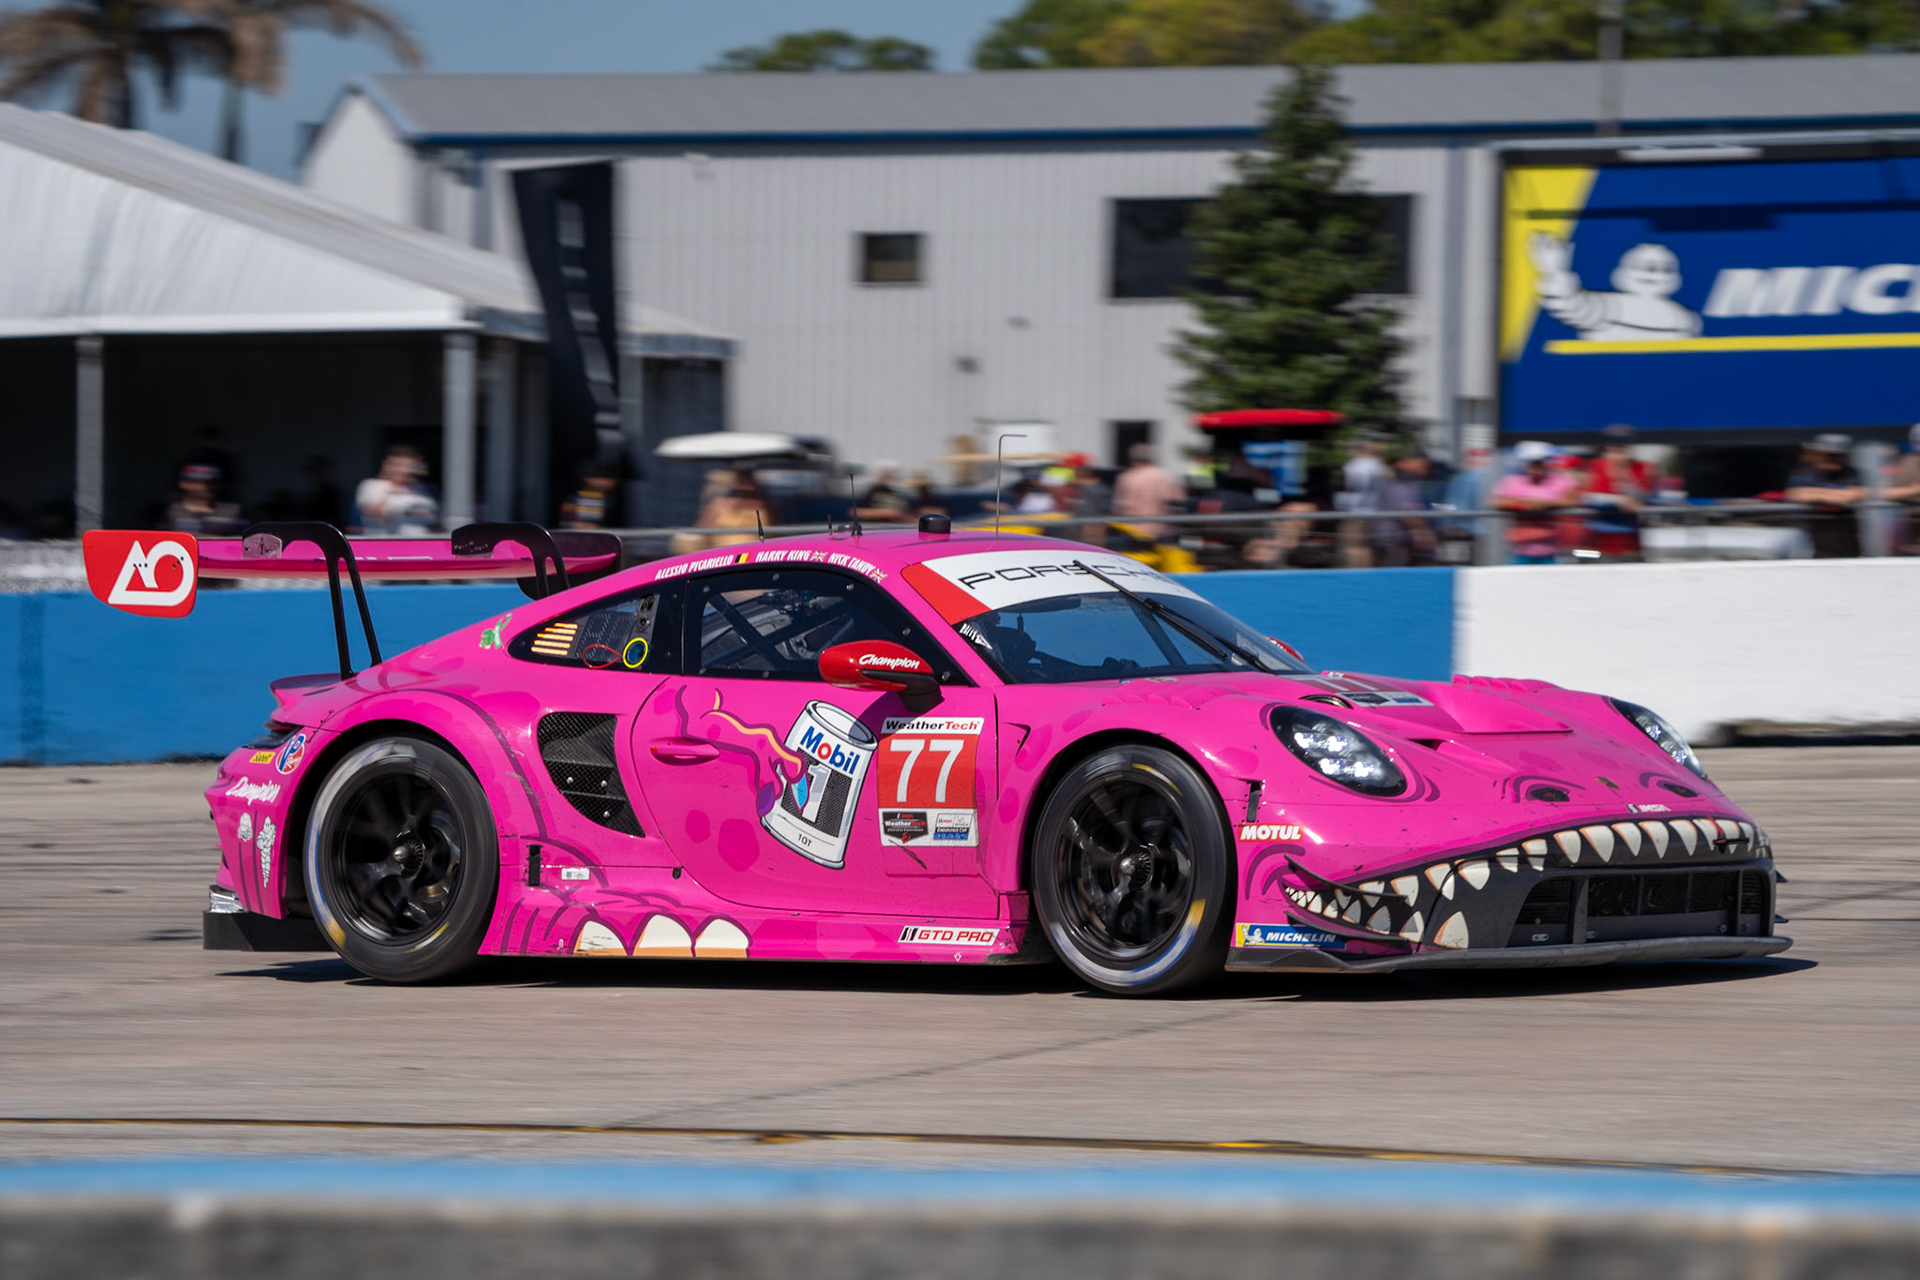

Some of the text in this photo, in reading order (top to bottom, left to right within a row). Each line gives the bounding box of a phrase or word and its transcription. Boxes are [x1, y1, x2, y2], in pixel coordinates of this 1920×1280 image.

[1701, 264, 1920, 318] MIC
[755, 549, 811, 563] HARRY KING
[828, 552, 876, 575] NICK TANDY
[655, 554, 734, 581] ALESSIO PICARIELLO
[858, 653, 920, 670] Champion
[886, 720, 978, 731] WeatherTech
[800, 725, 860, 775] Mobil
[889, 738, 965, 803] 77
[801, 761, 832, 823] 1
[1240, 824, 1302, 841] MOTUL
[917, 929, 995, 942] GTD PRO
[1265, 931, 1337, 944] MICHELIN
